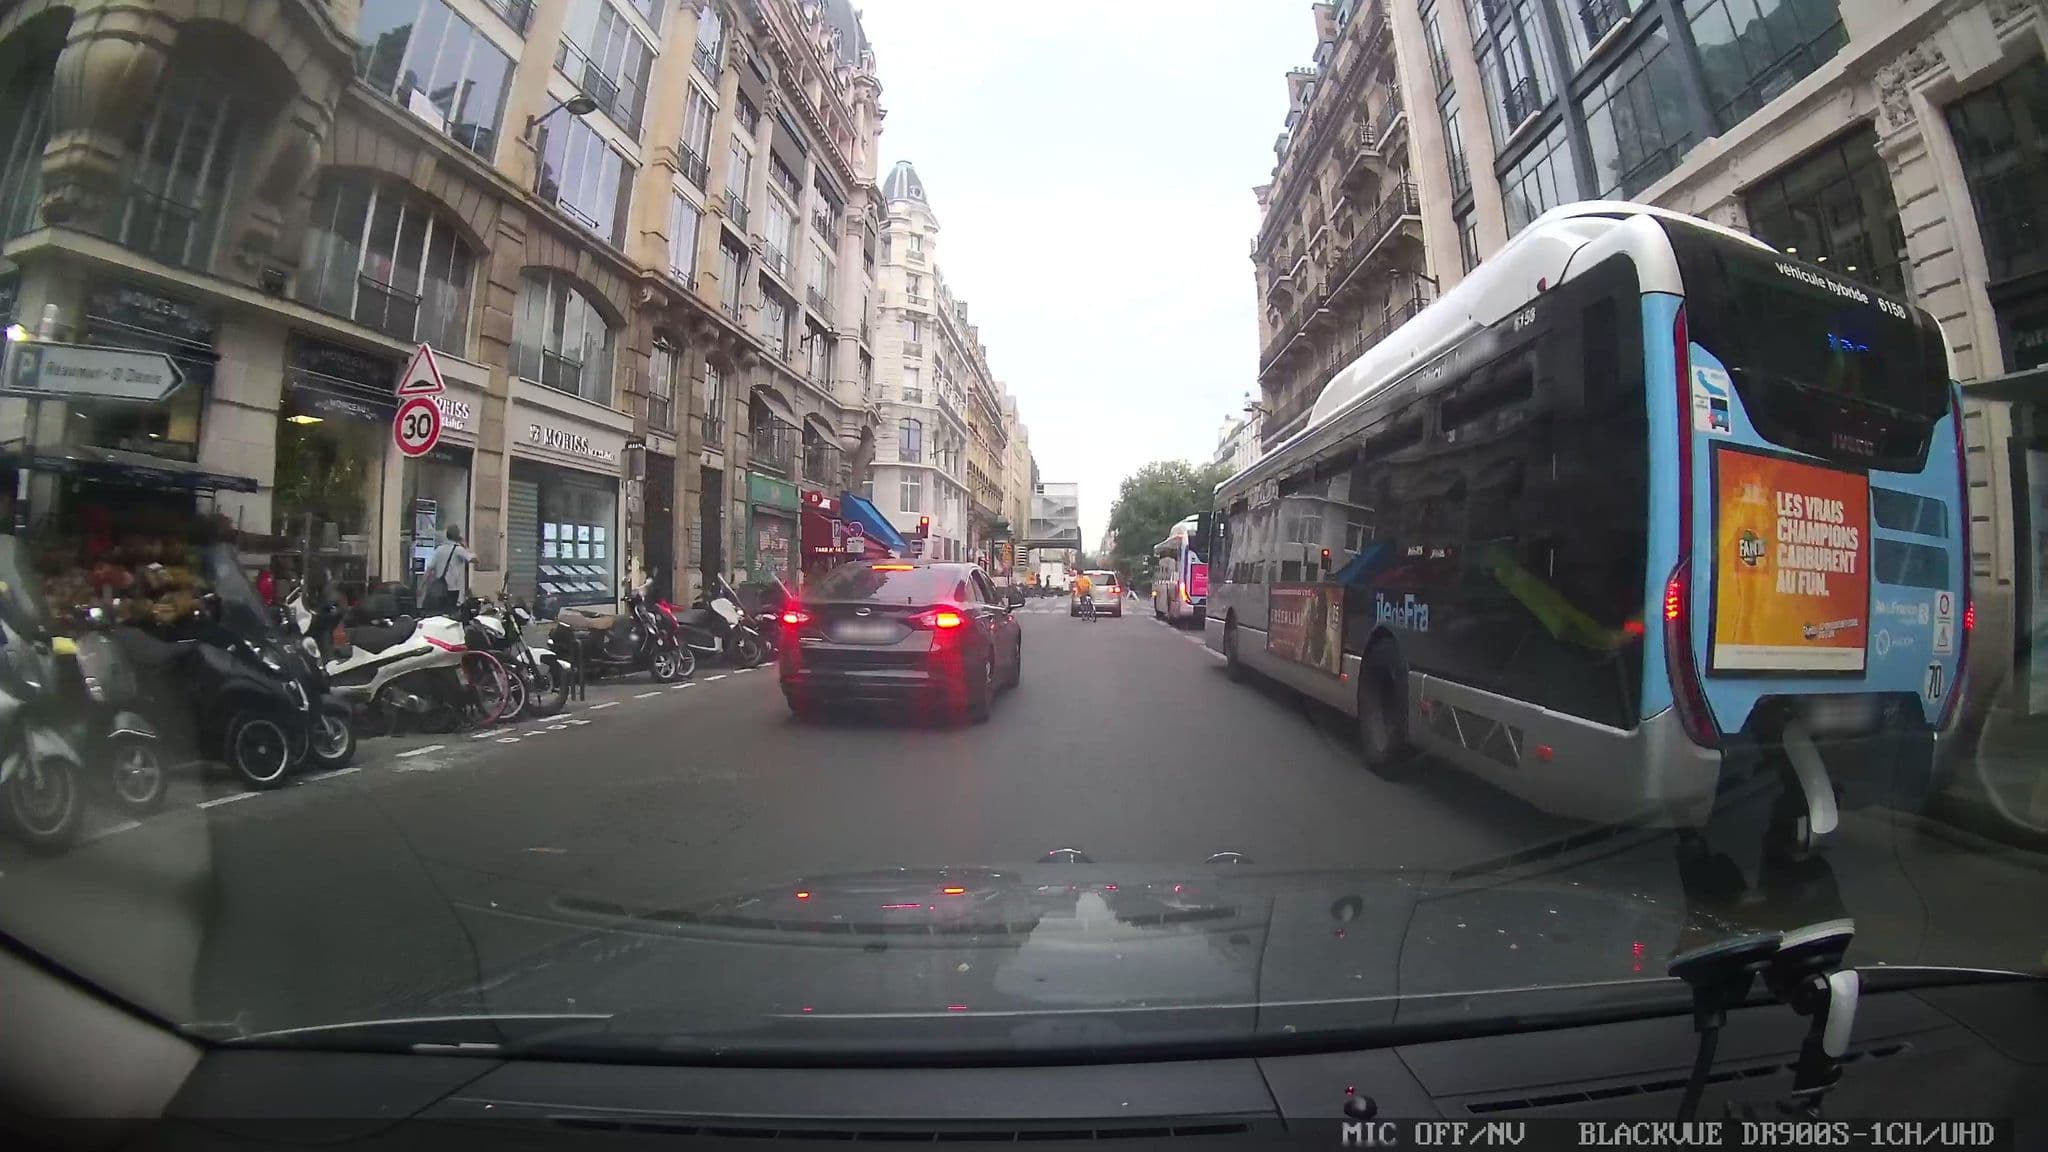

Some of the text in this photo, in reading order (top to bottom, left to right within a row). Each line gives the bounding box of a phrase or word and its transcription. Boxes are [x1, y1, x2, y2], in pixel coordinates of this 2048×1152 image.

[1775, 262, 1907, 320] véhicule hybride 6158
[402, 413, 432, 440] 30
[543, 427, 589, 455] MORISS
[1776, 491, 1844, 524] LES VRAIS
[1776, 516, 1859, 551] CHAMPIONS
[1776, 542, 1857, 575] CARBURENT
[1776, 569, 1830, 597] AU FUN.
[1928, 664, 1942, 700] 70
